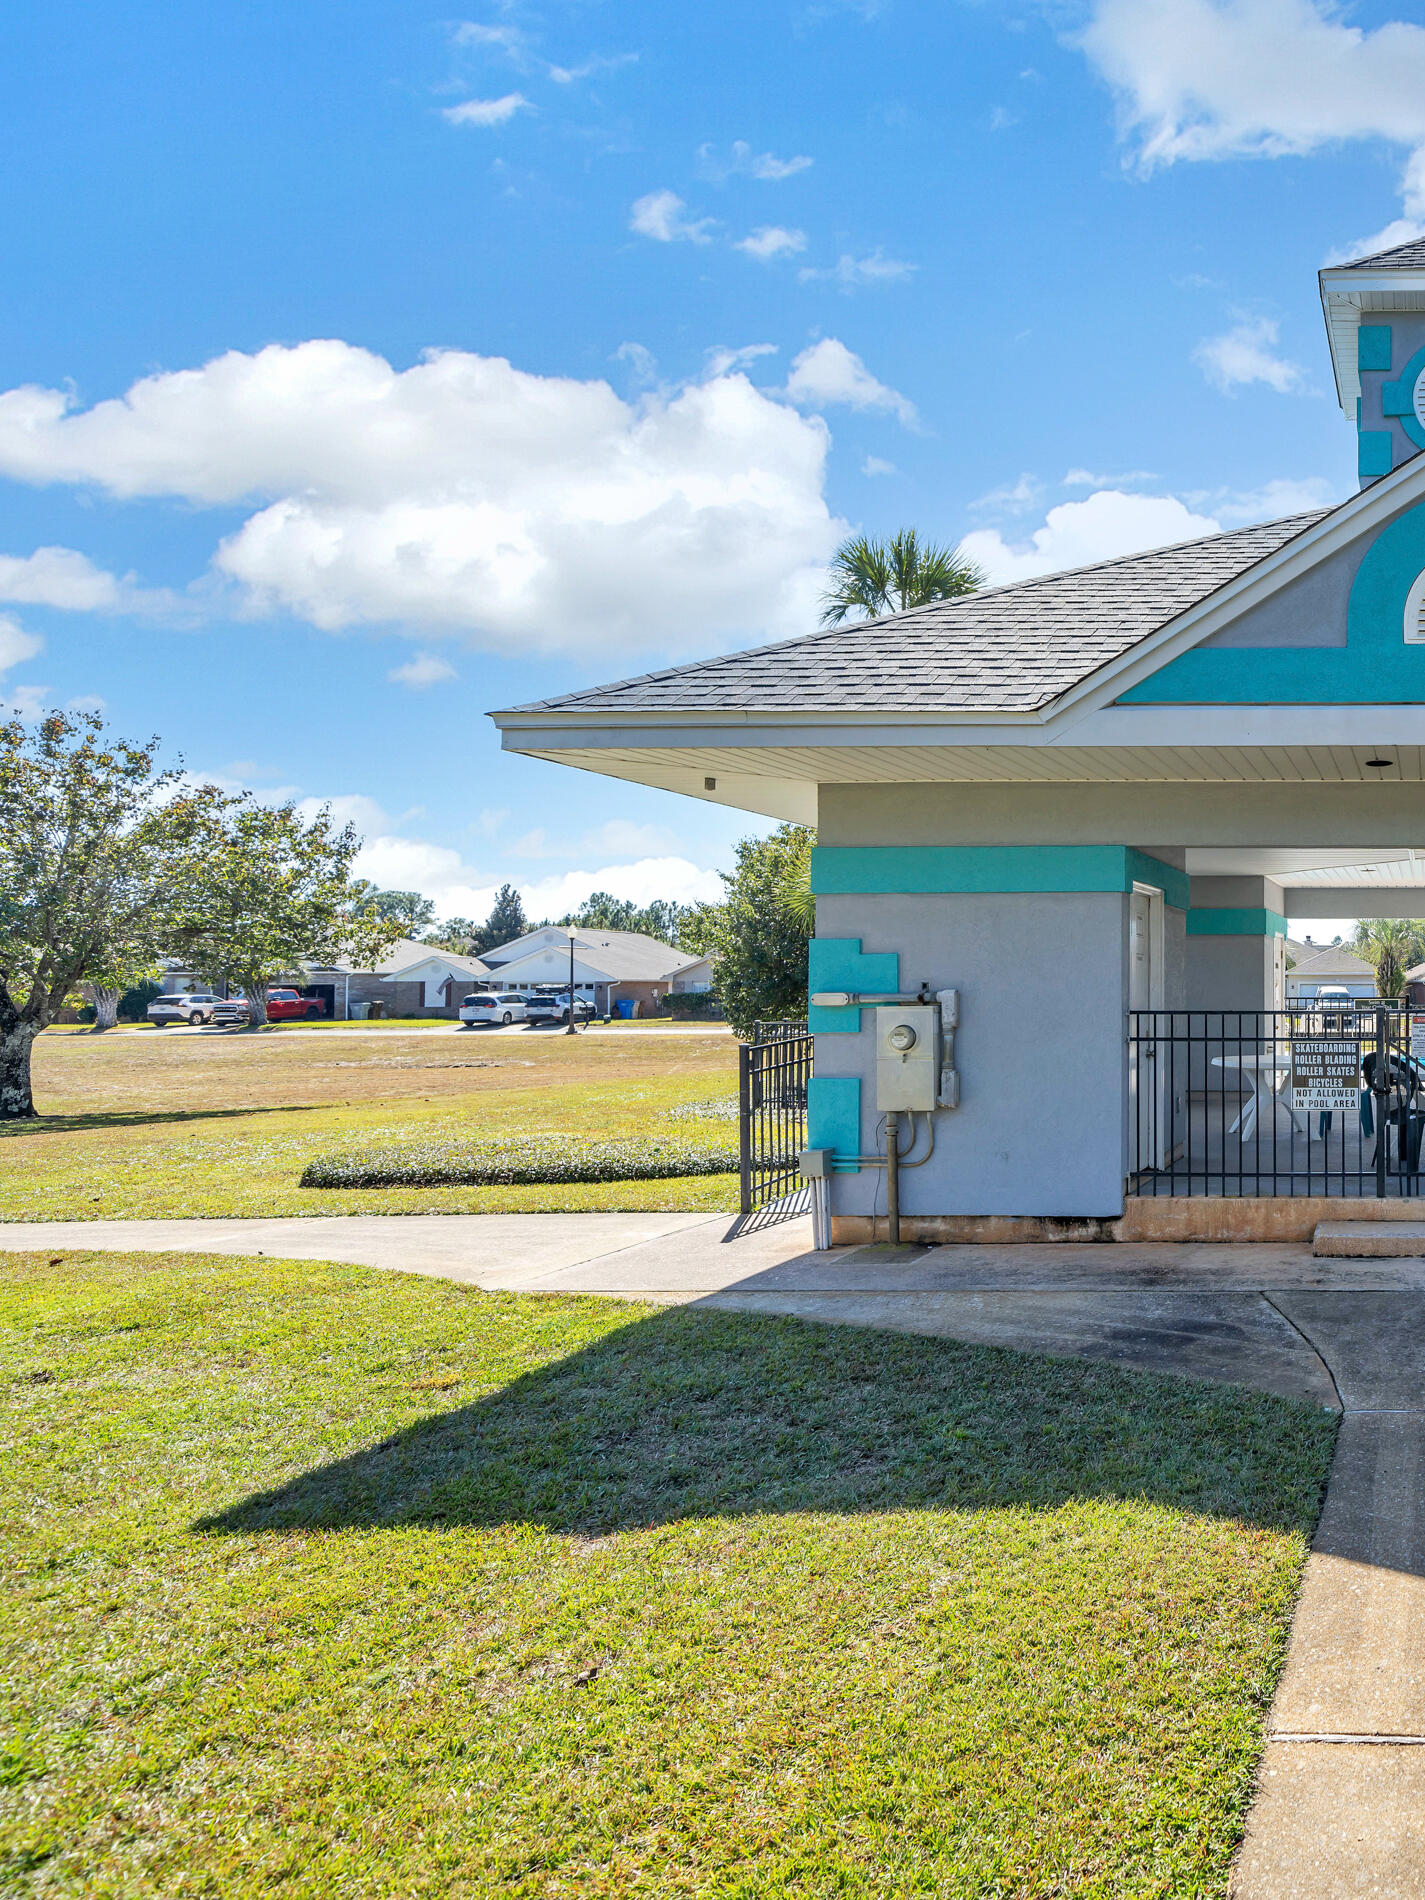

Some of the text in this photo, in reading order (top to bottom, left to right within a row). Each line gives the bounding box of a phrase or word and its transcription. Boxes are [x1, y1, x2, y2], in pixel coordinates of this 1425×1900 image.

[1295, 1044, 1357, 1053] SKATEBOARDING
[1295, 1055, 1357, 1064] ROLLER BLADING
[1297, 1066, 1355, 1076] ROLLER SKATES
[1308, 1078, 1343, 1088] BICYCLES
[1296, 1089, 1355, 1097] NOT ALLOWED
[1295, 1099, 1356, 1108] IN POOL AREA
